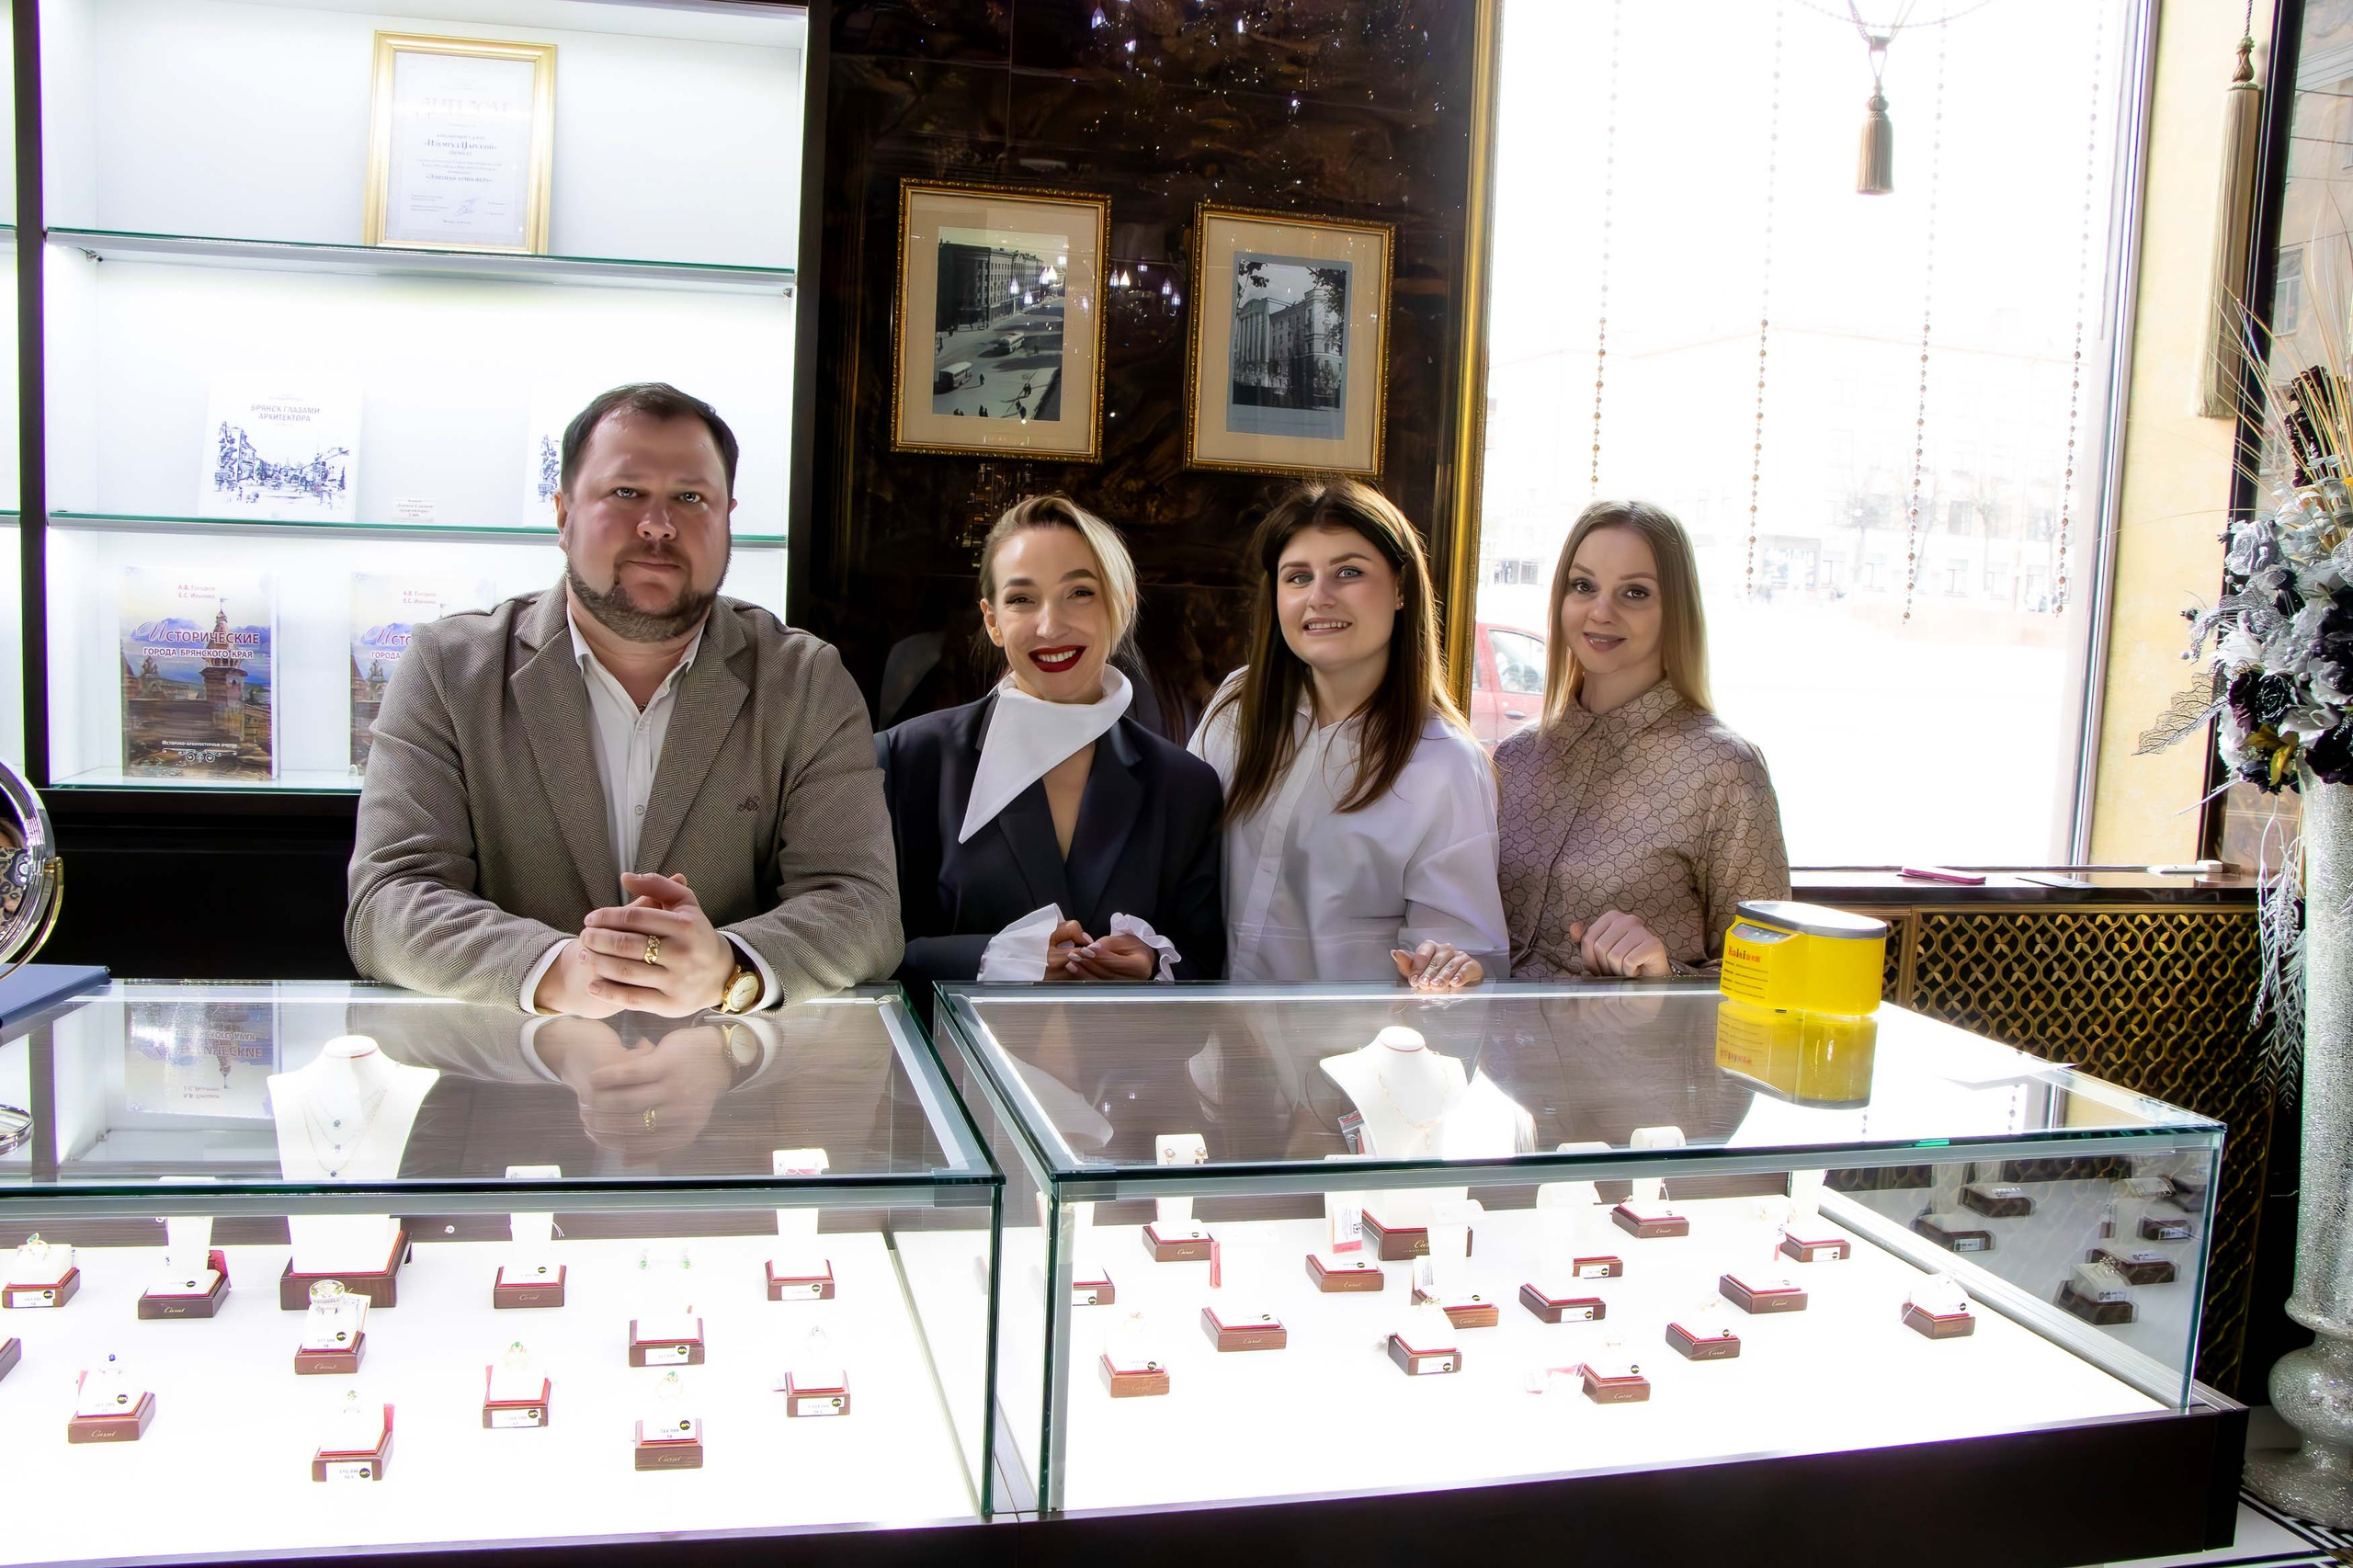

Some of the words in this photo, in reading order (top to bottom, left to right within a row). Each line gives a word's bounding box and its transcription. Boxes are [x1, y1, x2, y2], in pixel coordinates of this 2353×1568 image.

[250, 403, 282, 413] БРЯНСК
[283, 405, 321, 415] ГЛАЗАМИ
[258, 413, 312, 422] АРХИТЕКТОРА
[143, 647, 177, 657] ГОРОДА
[179, 648, 229, 658] БРЯНСКОГО
[231, 650, 254, 659] КРАЯ
[371, 651, 401, 660] ГОРОДА
[91, 1428, 117, 1438] Carat
[657, 1454, 682, 1463] Carat
